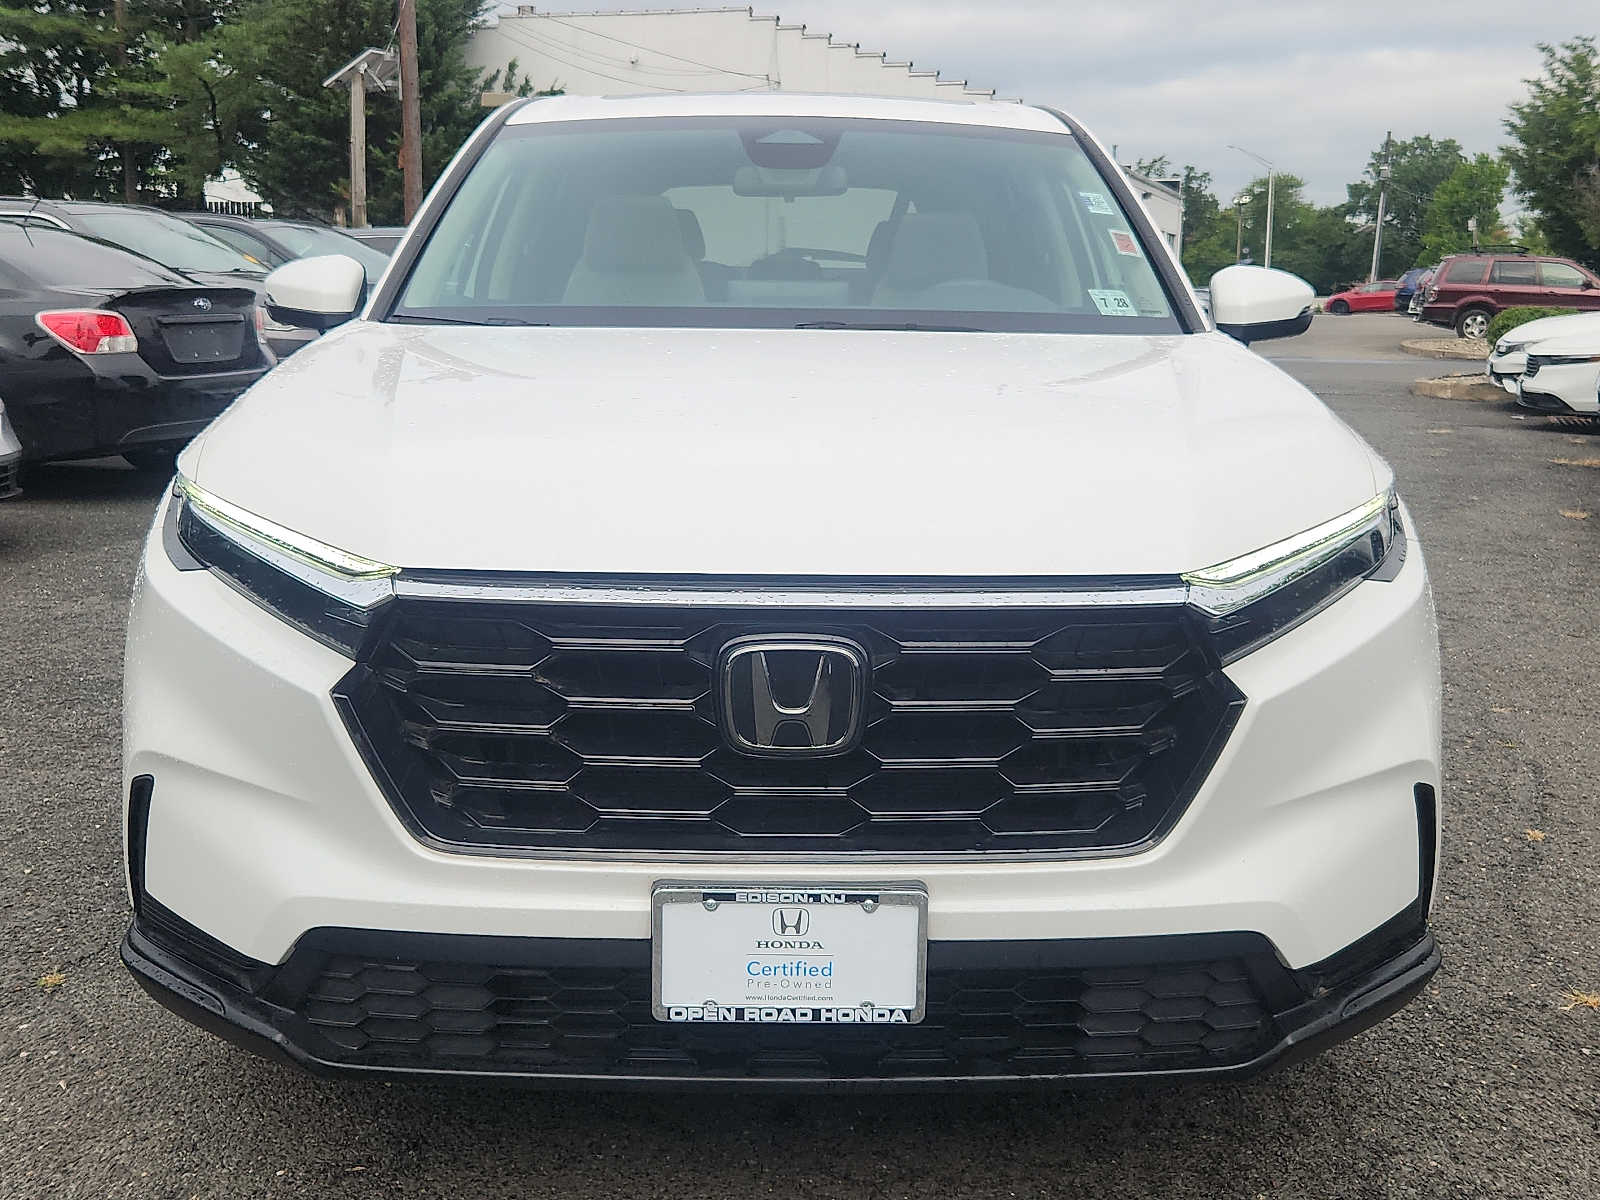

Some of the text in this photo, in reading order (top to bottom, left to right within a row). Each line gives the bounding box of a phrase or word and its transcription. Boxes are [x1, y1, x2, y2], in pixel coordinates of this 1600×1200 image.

[735, 892, 846, 904] EDISON, NJ
[756, 940, 825, 949] HONDA
[746, 961, 833, 977] Certified
[747, 979, 832, 988] Pre-Owned
[669, 1007, 908, 1023] OPEN ROAD HONDA
